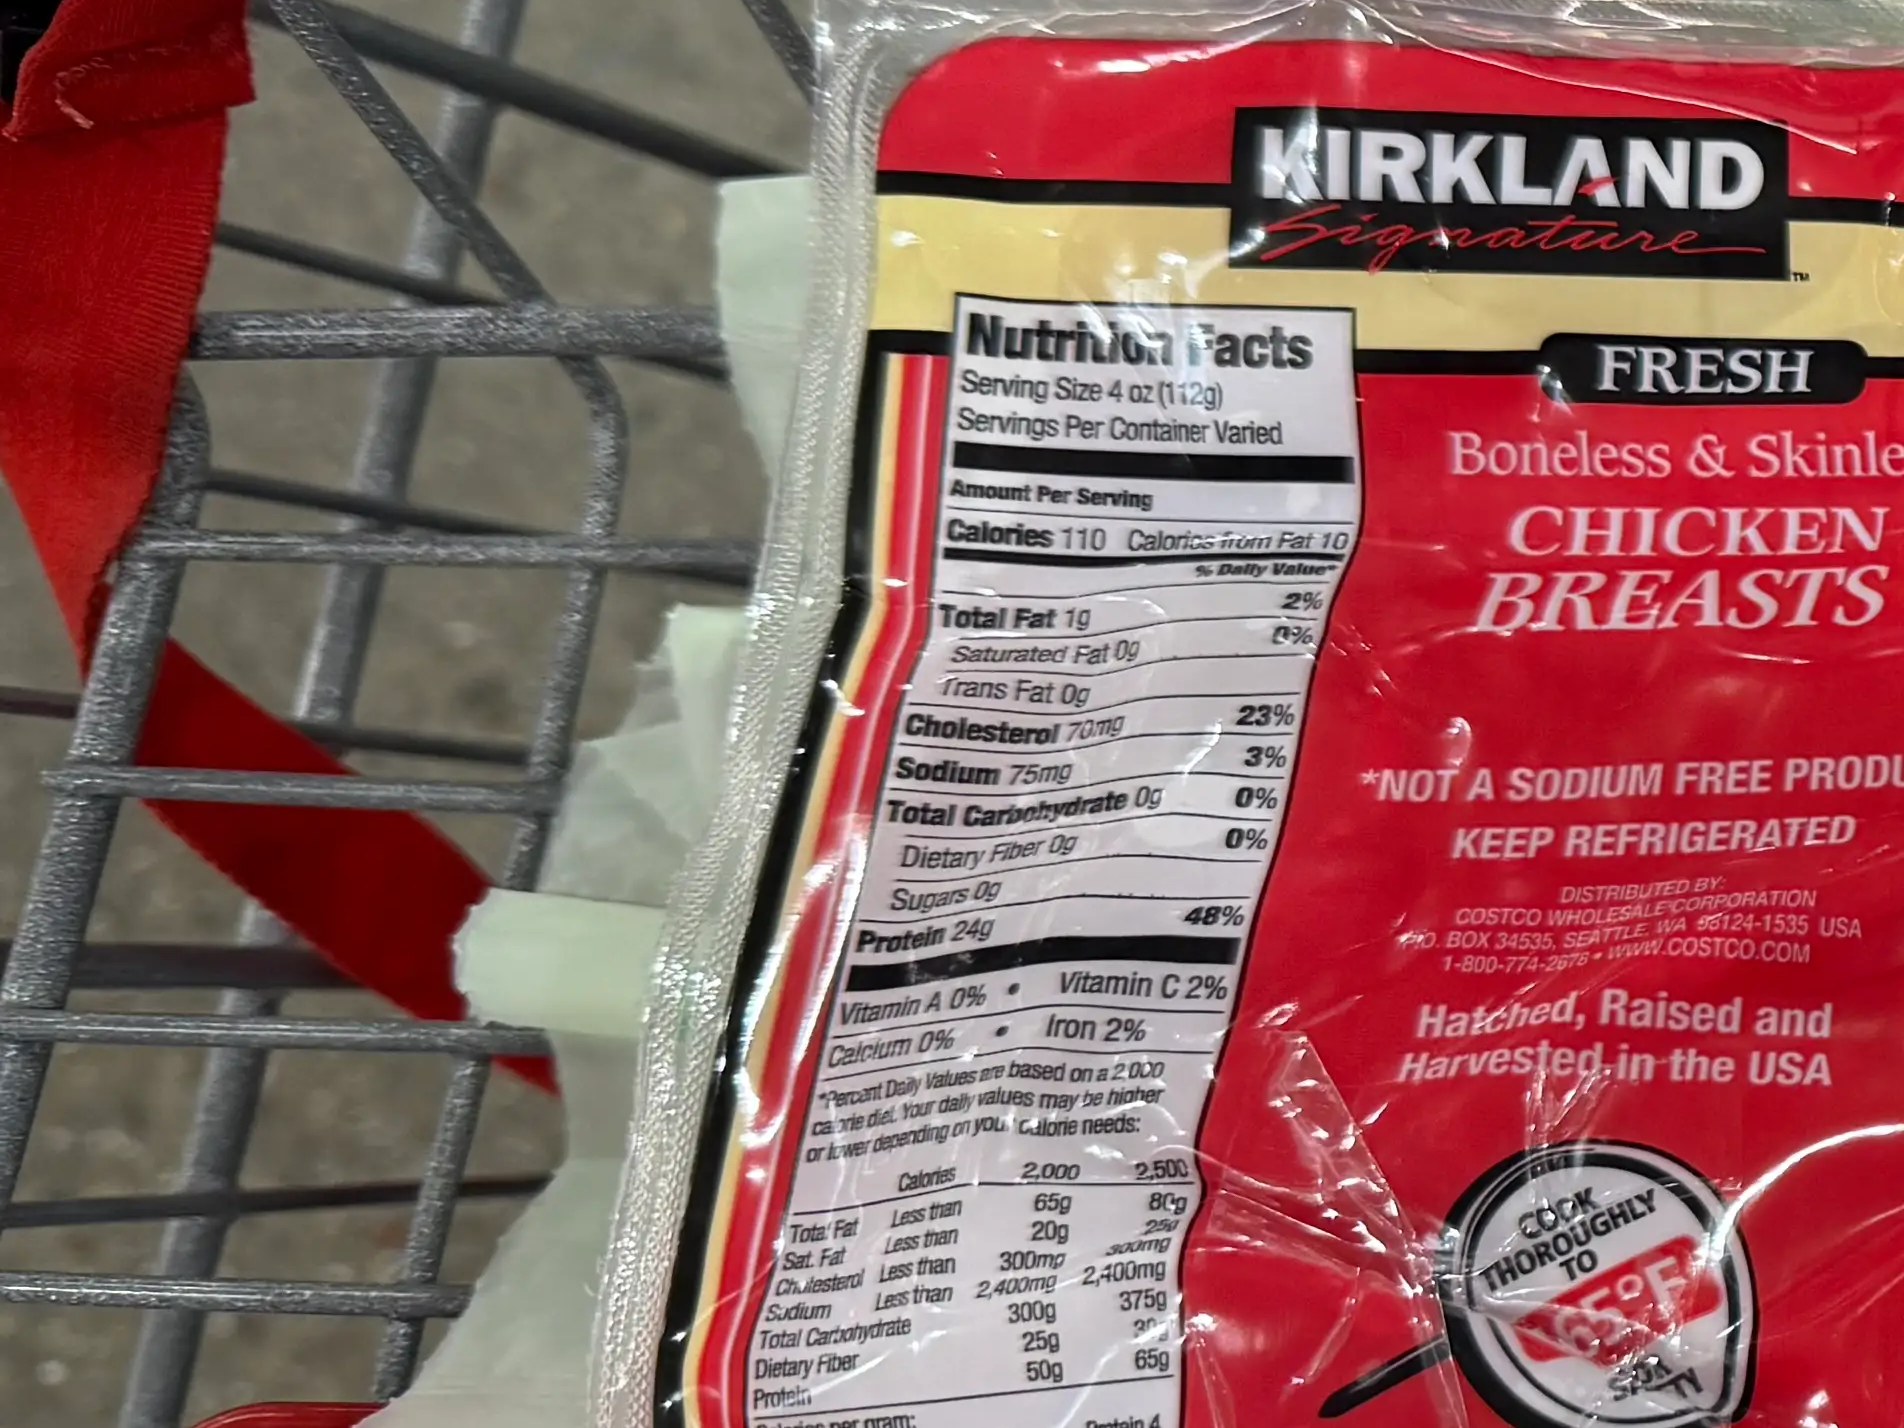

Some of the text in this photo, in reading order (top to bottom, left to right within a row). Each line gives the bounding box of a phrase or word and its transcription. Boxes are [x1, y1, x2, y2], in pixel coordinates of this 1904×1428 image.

[1260, 124, 1766, 211] KIRKLAND
[1259, 204, 1766, 274] Signature
[1188, 322, 1314, 369] Facts
[1598, 345, 1815, 395] FRESH
[1449, 429, 1671, 477] Boneless
[1689, 435, 1735, 477] &
[1508, 504, 1891, 558] CHICKEN
[1476, 563, 1890, 635] BREASTS
[1451, 814, 1857, 860] KEEP REFRIGERATED
[1480, 1188, 1657, 1292] THOROUGHLY
